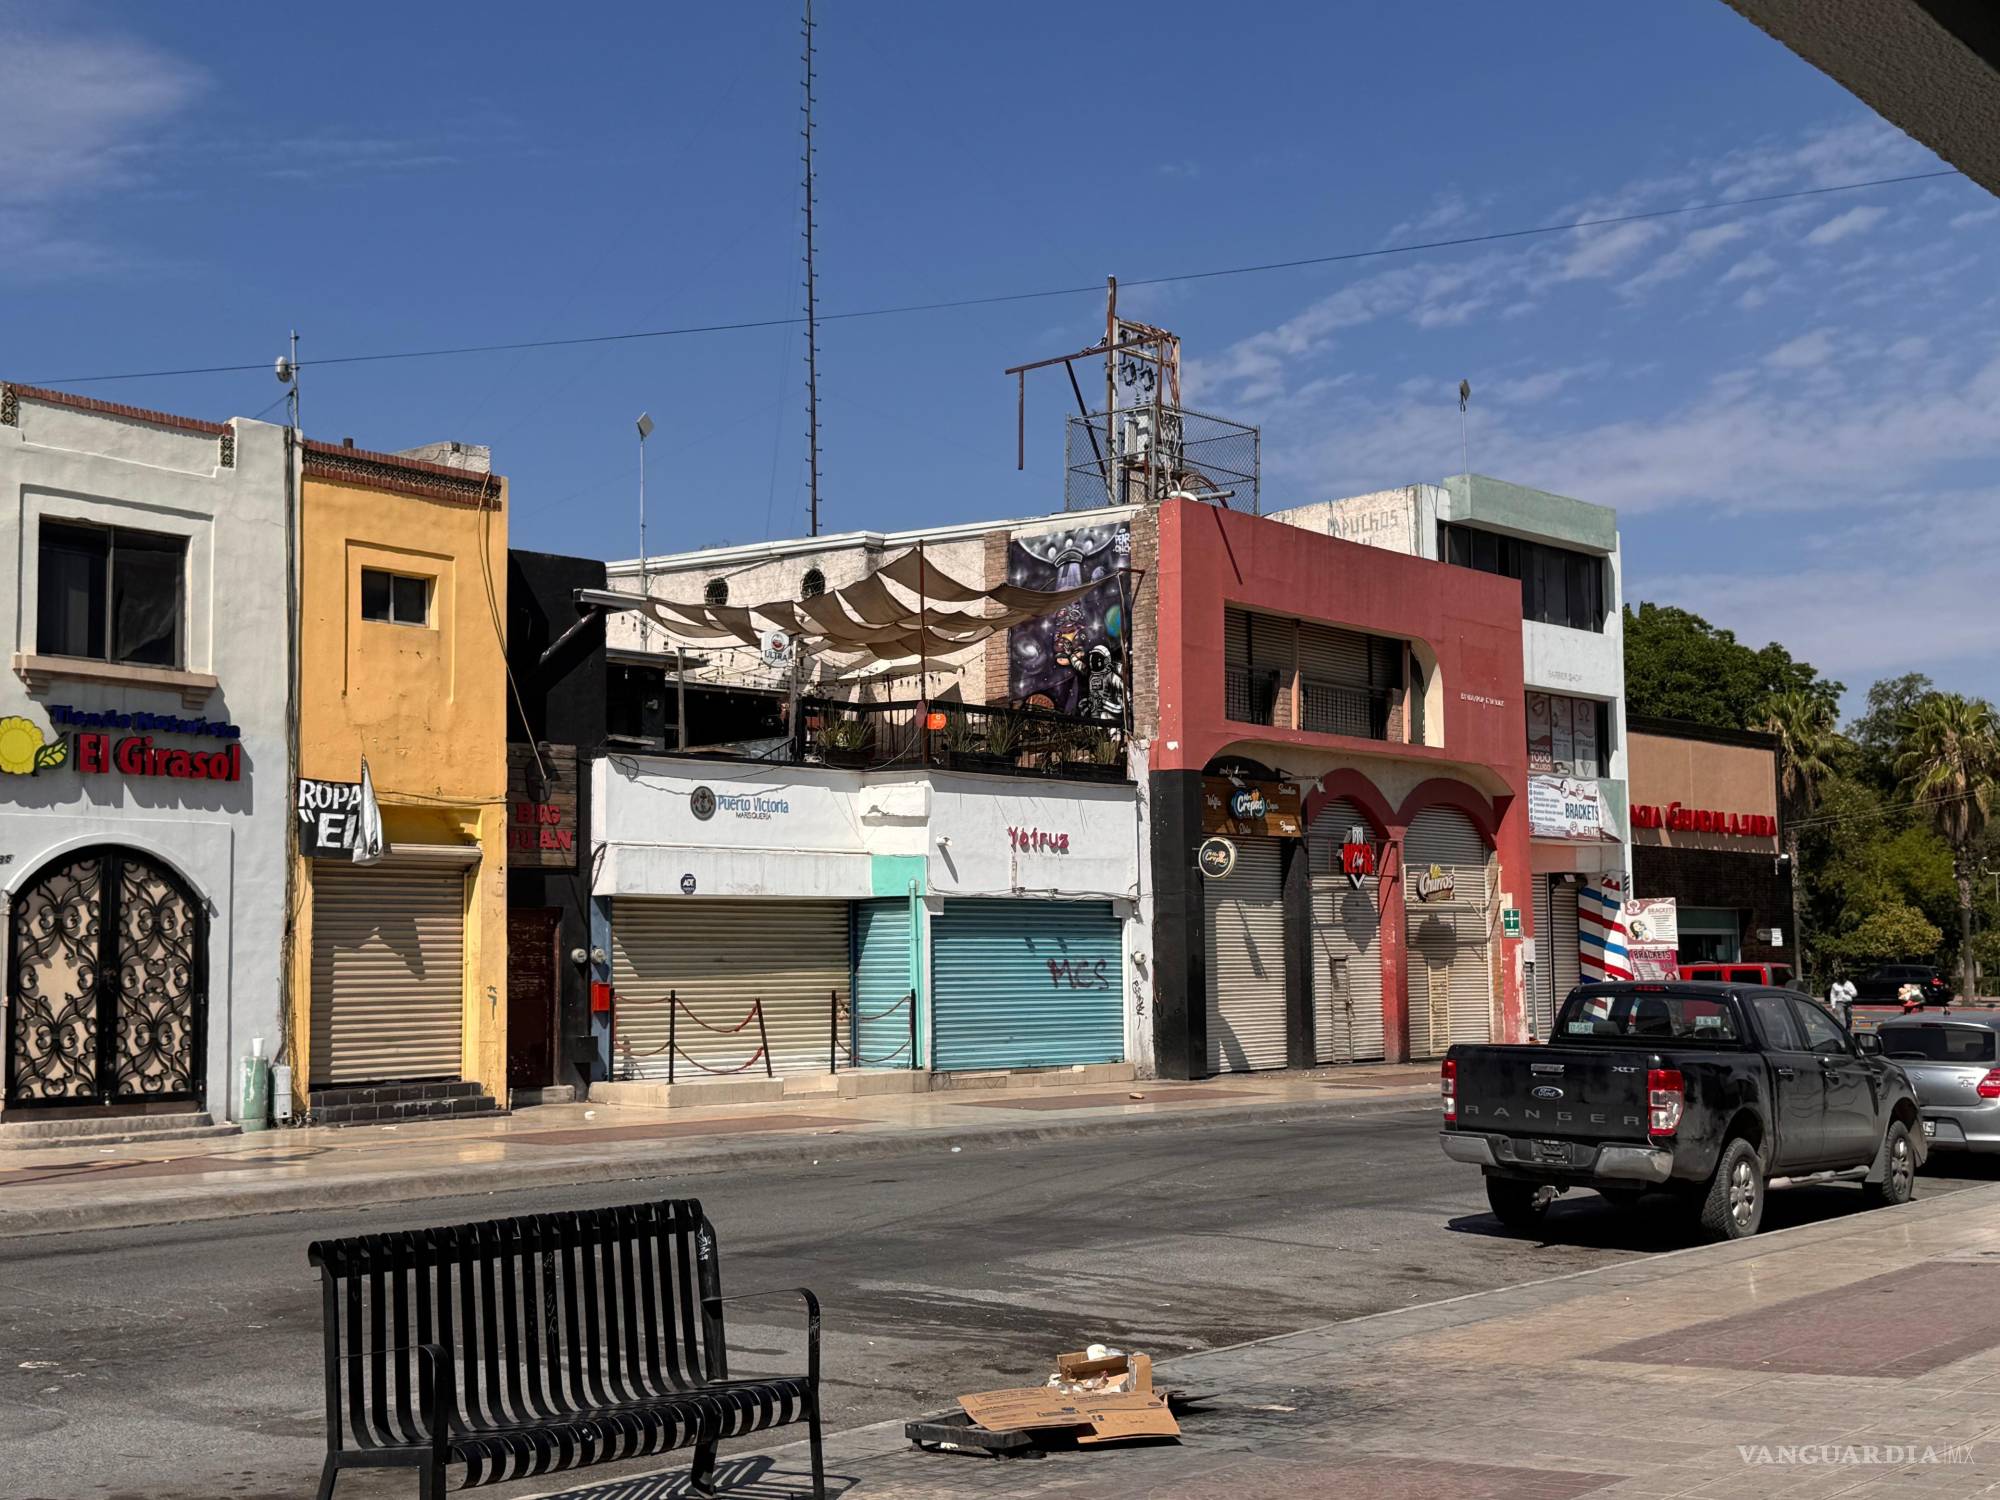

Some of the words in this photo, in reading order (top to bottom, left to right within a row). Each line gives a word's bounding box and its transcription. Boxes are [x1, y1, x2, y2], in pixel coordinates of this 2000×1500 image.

[764, 650, 788, 661] ULTRA
[78, 733, 110, 774] El
[117, 735, 241, 782] Girasol
[298, 780, 362, 810] ROPA
[717, 795, 751, 812] Puerto
[753, 797, 789, 814] Victoria
[516, 802, 561, 825] BIG
[1564, 802, 1599, 821] BRACKETS
[1537, 1087, 1557, 1098] Ford
[1464, 1105, 1640, 1126] RANGER
